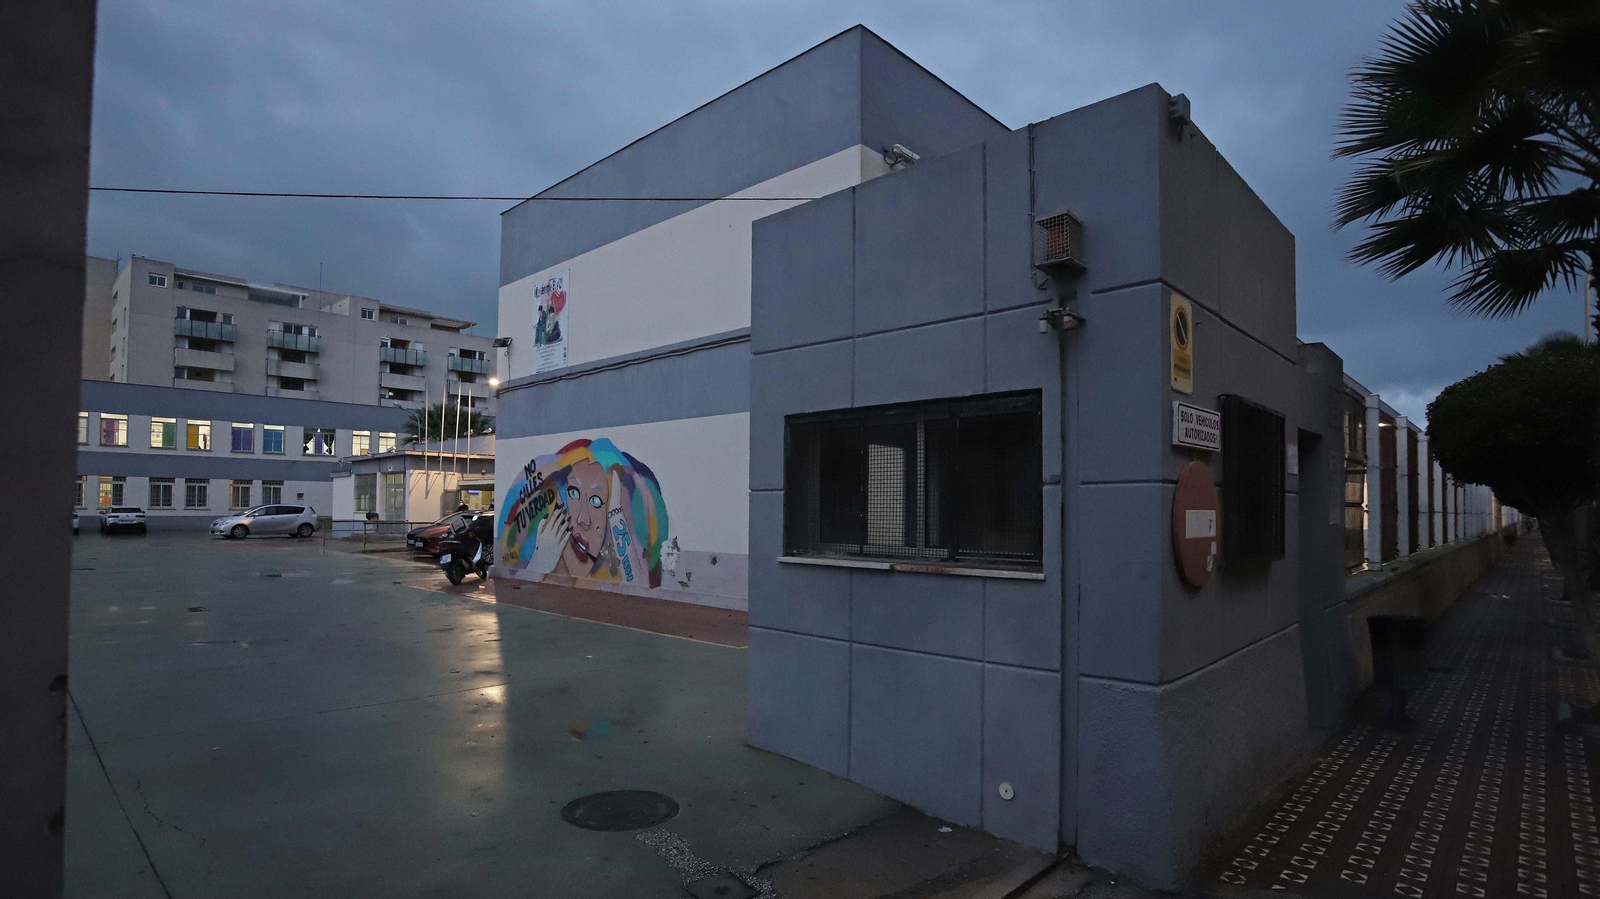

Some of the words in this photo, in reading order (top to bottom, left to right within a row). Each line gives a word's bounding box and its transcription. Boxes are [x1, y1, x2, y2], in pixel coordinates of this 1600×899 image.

[1181, 410, 1194, 424] SOLO
[1185, 427, 1216, 444] AUTORIZADOS
[524, 459, 536, 481] NO
[519, 472, 545, 505] CALLES
[514, 511, 527, 534] TU
[524, 488, 556, 521] VERDAD
[612, 518, 631, 557] 25
